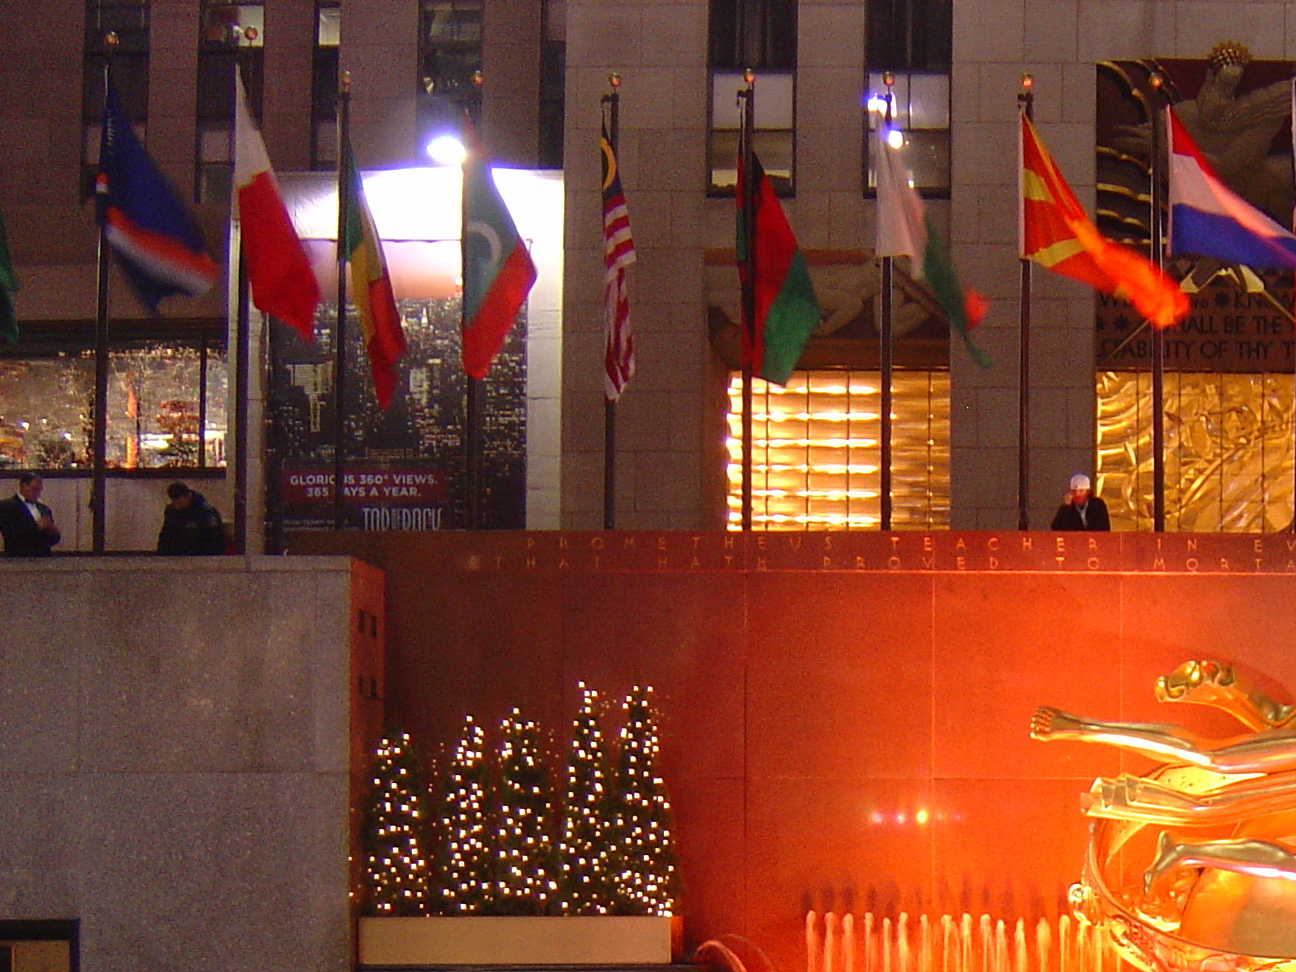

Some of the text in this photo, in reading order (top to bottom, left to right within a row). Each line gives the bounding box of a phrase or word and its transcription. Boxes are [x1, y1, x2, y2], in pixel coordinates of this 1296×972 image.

[1224, 315, 1246, 334] BE
[1252, 315, 1281, 334] THE
[1201, 341, 1229, 359] OF
[1237, 341, 1273, 359] THY
[393, 475, 438, 485] VIEWS.
[307, 487, 329, 497] 365
[369, 487, 379, 497] A
[383, 487, 422, 497] YEAR.
[890, 537, 1098, 551] TEACHER
[1156, 538, 1198, 551] IN
[495, 556, 601, 569] THAT
[657, 556, 768, 570] HATH
[823, 556, 999, 570] PROVED
[1055, 557, 1100, 570] TO
